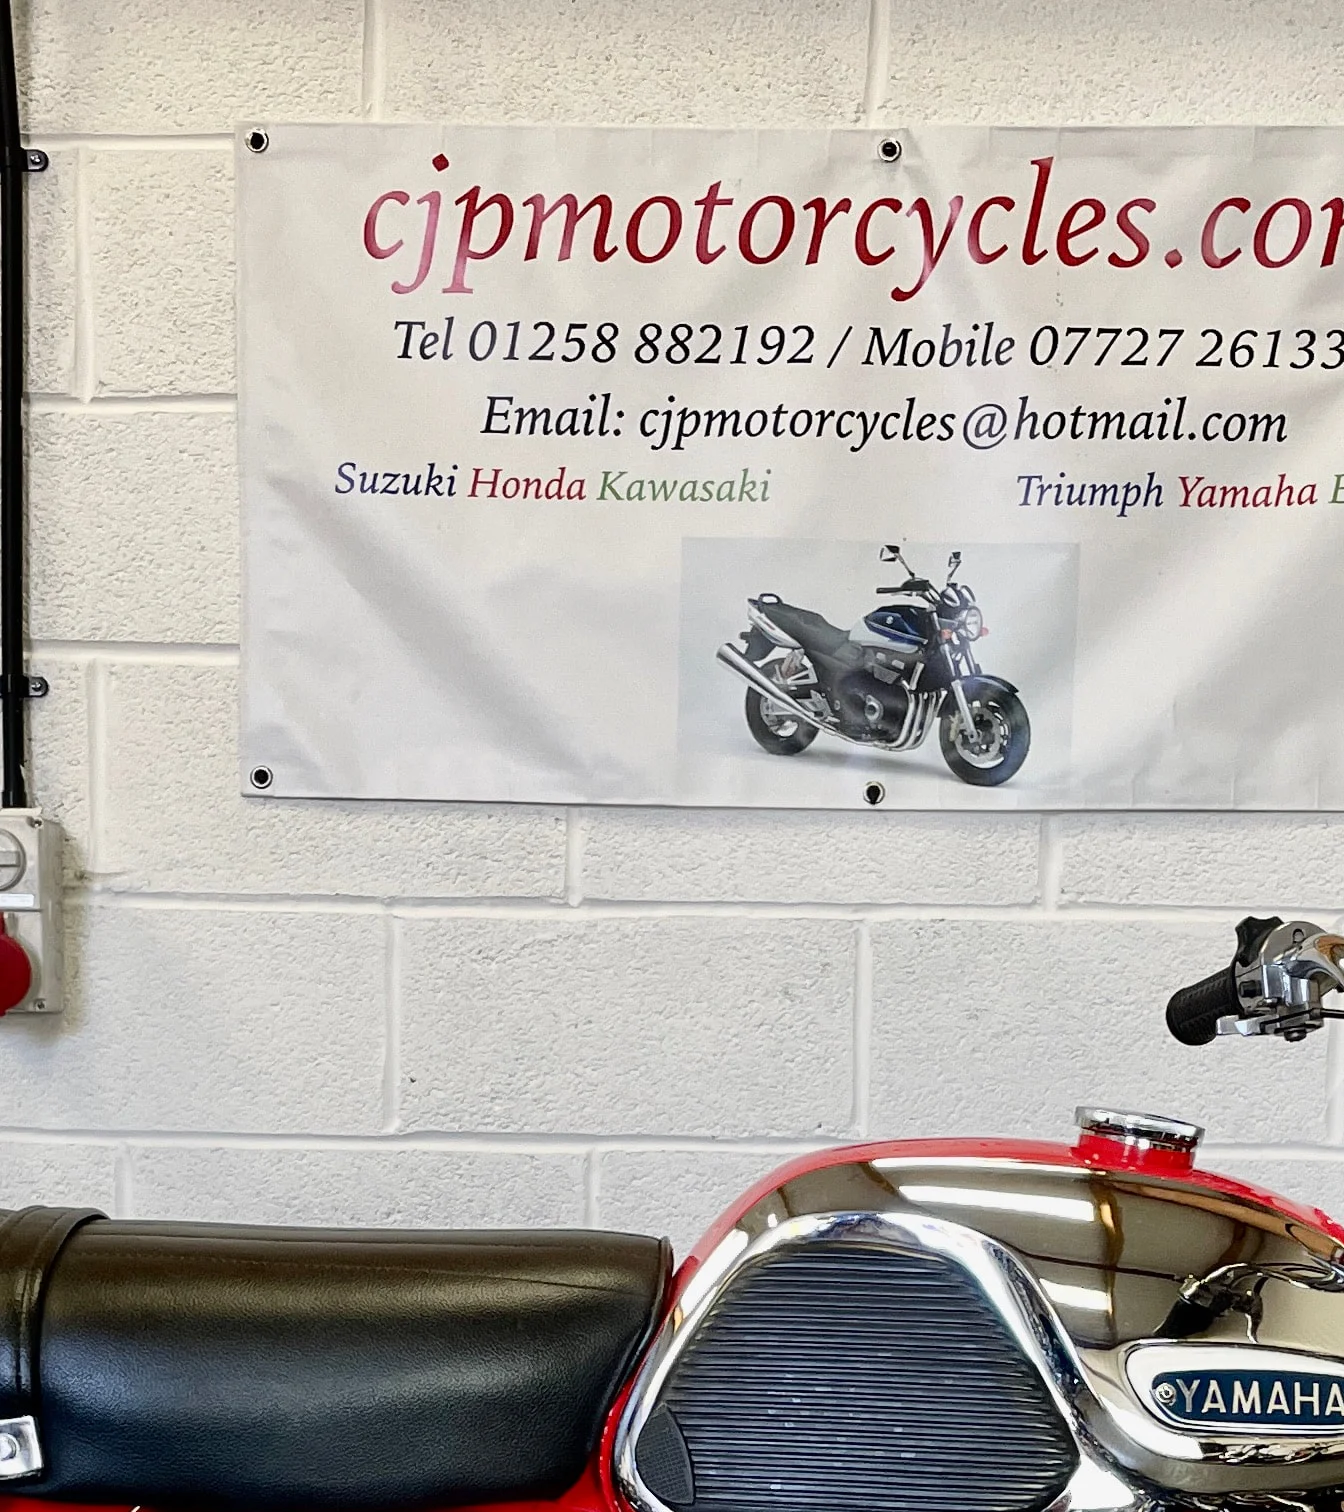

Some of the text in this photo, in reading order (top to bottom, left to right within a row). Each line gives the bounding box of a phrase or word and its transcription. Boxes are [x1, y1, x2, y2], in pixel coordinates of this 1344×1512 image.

[393, 316, 455, 361] Tel
[467, 320, 620, 364] 01258
[633, 322, 816, 366] 882192
[827, 324, 852, 369] /
[861, 322, 1016, 369] Mobile
[1028, 324, 1186, 368] 07727
[479, 393, 1289, 453] Email: cjpmotorcycles@hotmail.com
[333, 461, 772, 504] Suzuki Honda Kawasaki
[1015, 471, 1164, 518] Triumph
[1176, 472, 1319, 510] Yamaha
